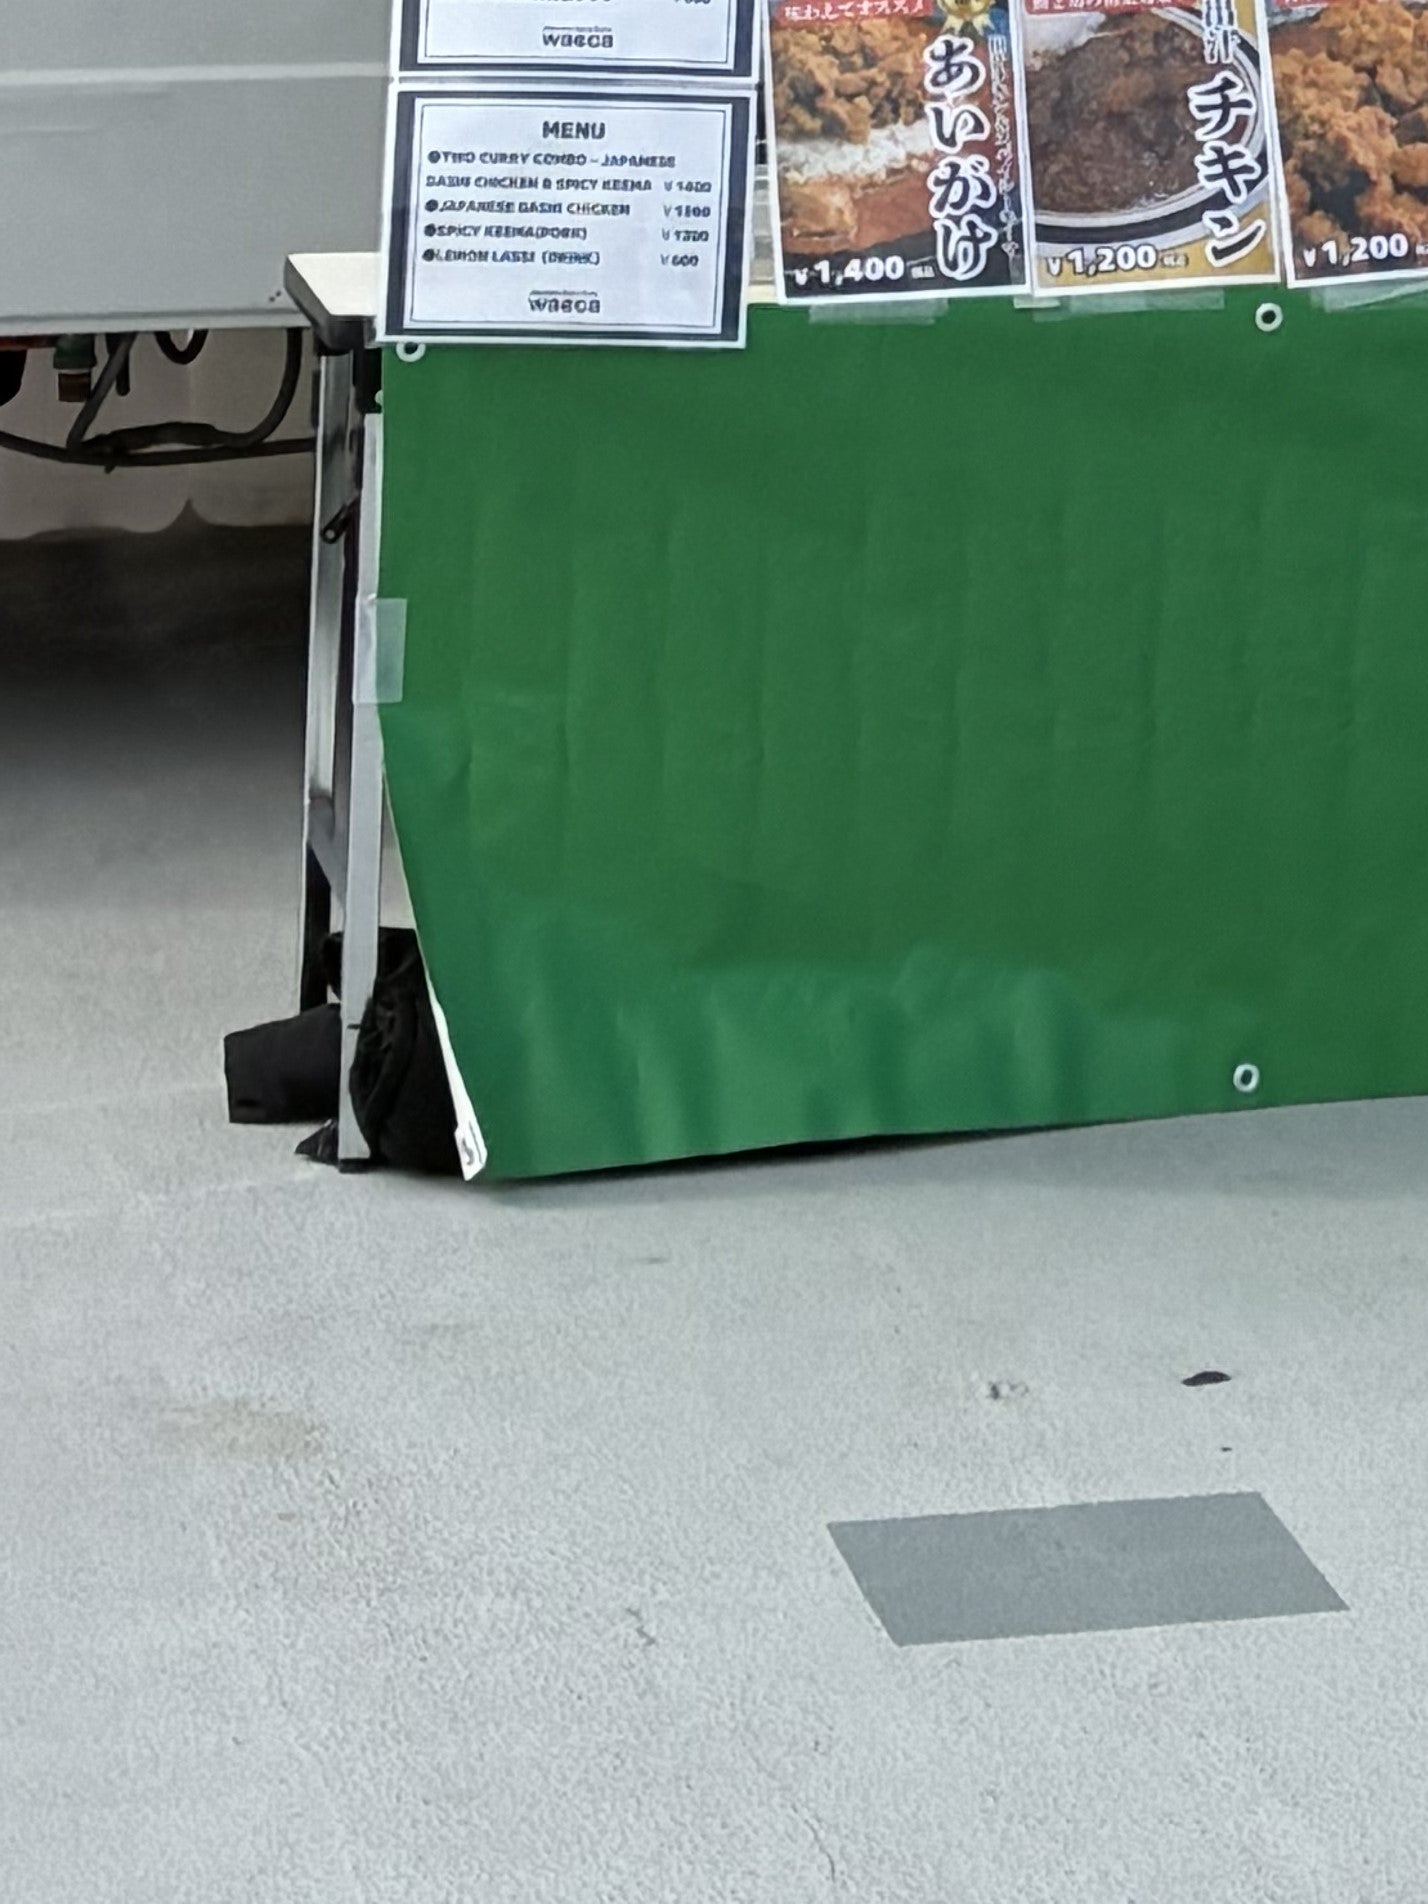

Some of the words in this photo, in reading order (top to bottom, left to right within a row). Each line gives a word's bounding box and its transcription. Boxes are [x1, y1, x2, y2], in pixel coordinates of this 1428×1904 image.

[542, 120, 606, 141] MENU
[922, 34, 999, 281] あいがけ
